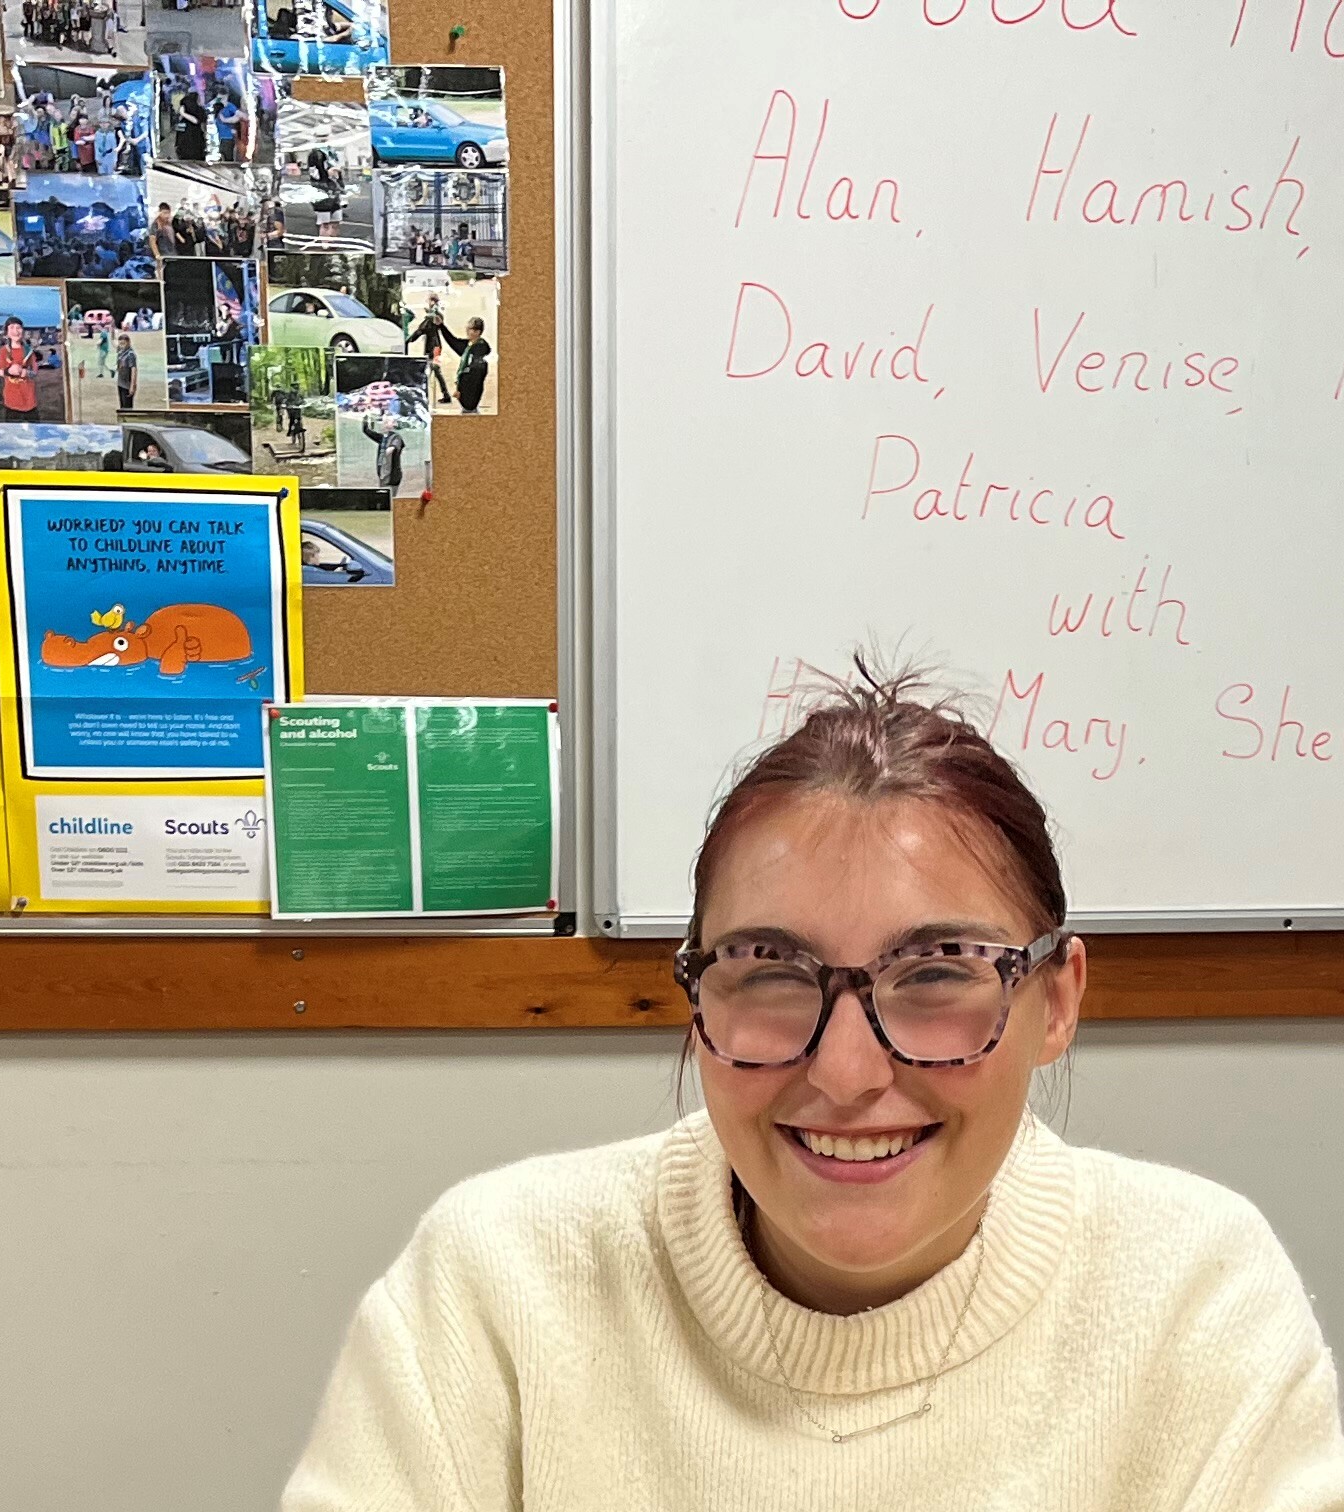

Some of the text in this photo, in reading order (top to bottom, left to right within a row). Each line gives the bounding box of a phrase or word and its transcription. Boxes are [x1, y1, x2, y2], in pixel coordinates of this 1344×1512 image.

[861, 434, 1126, 540] Patricia
[47, 518, 247, 536] WORRIED? YOU CAN TALK
[68, 537, 227, 555] TO CHILDLINE ABOUT
[1046, 564, 1190, 646] with
[279, 715, 341, 729] Scouting
[279, 728, 358, 739] and alcohol
[49, 817, 230, 835] childline Scouts
